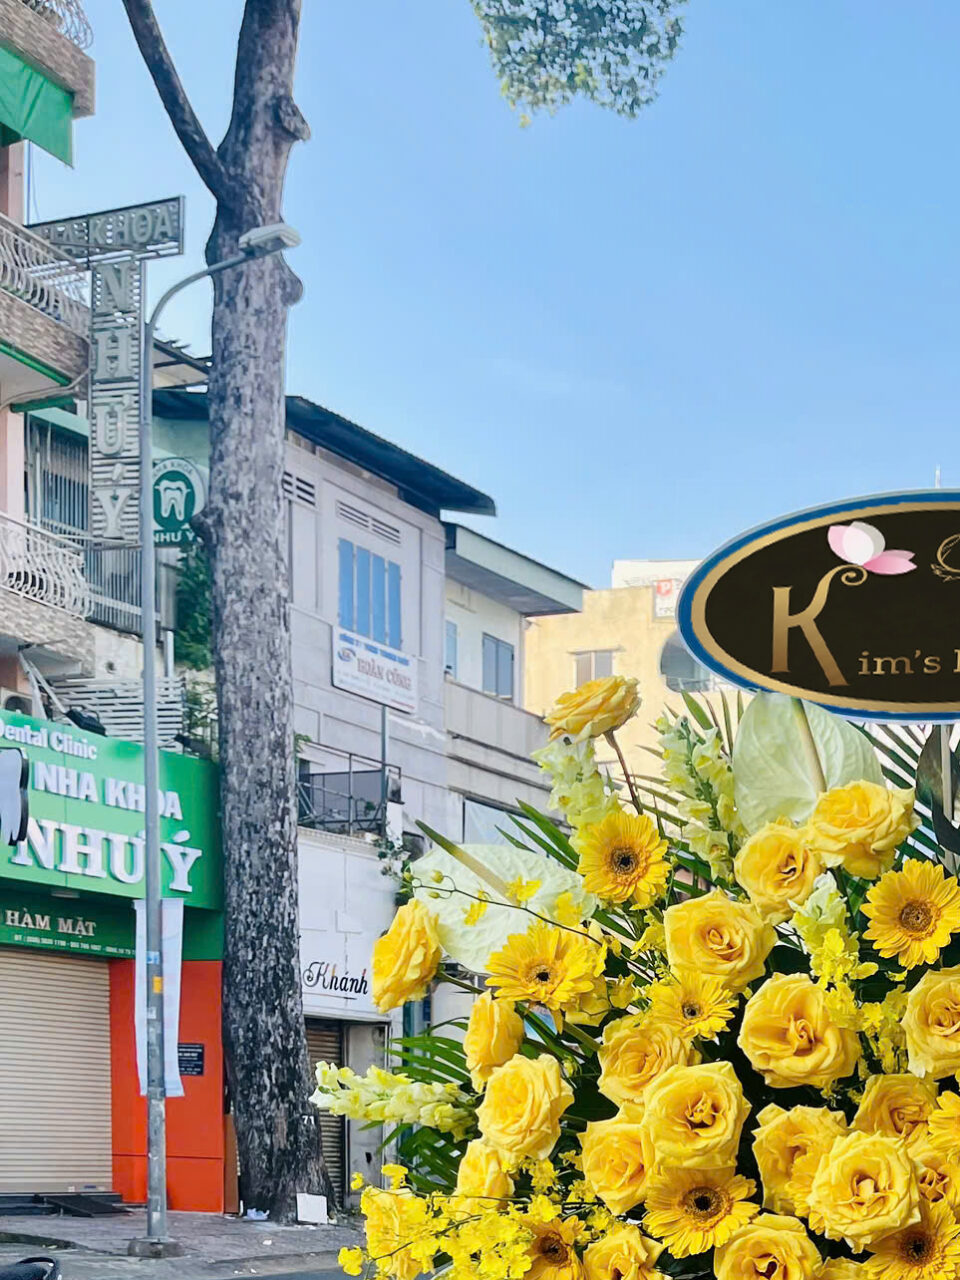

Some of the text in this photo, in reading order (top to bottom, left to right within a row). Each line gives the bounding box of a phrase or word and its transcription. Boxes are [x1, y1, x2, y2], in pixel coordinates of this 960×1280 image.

[88, 205, 175, 246] KHOA
[50, 731, 97, 760] Clinic
[33, 761, 98, 802] NHA
[160, 829, 202, 892] Ý
[5, 907, 96, 939] HÀM MẶT
[302, 961, 368, 995] Khánh
